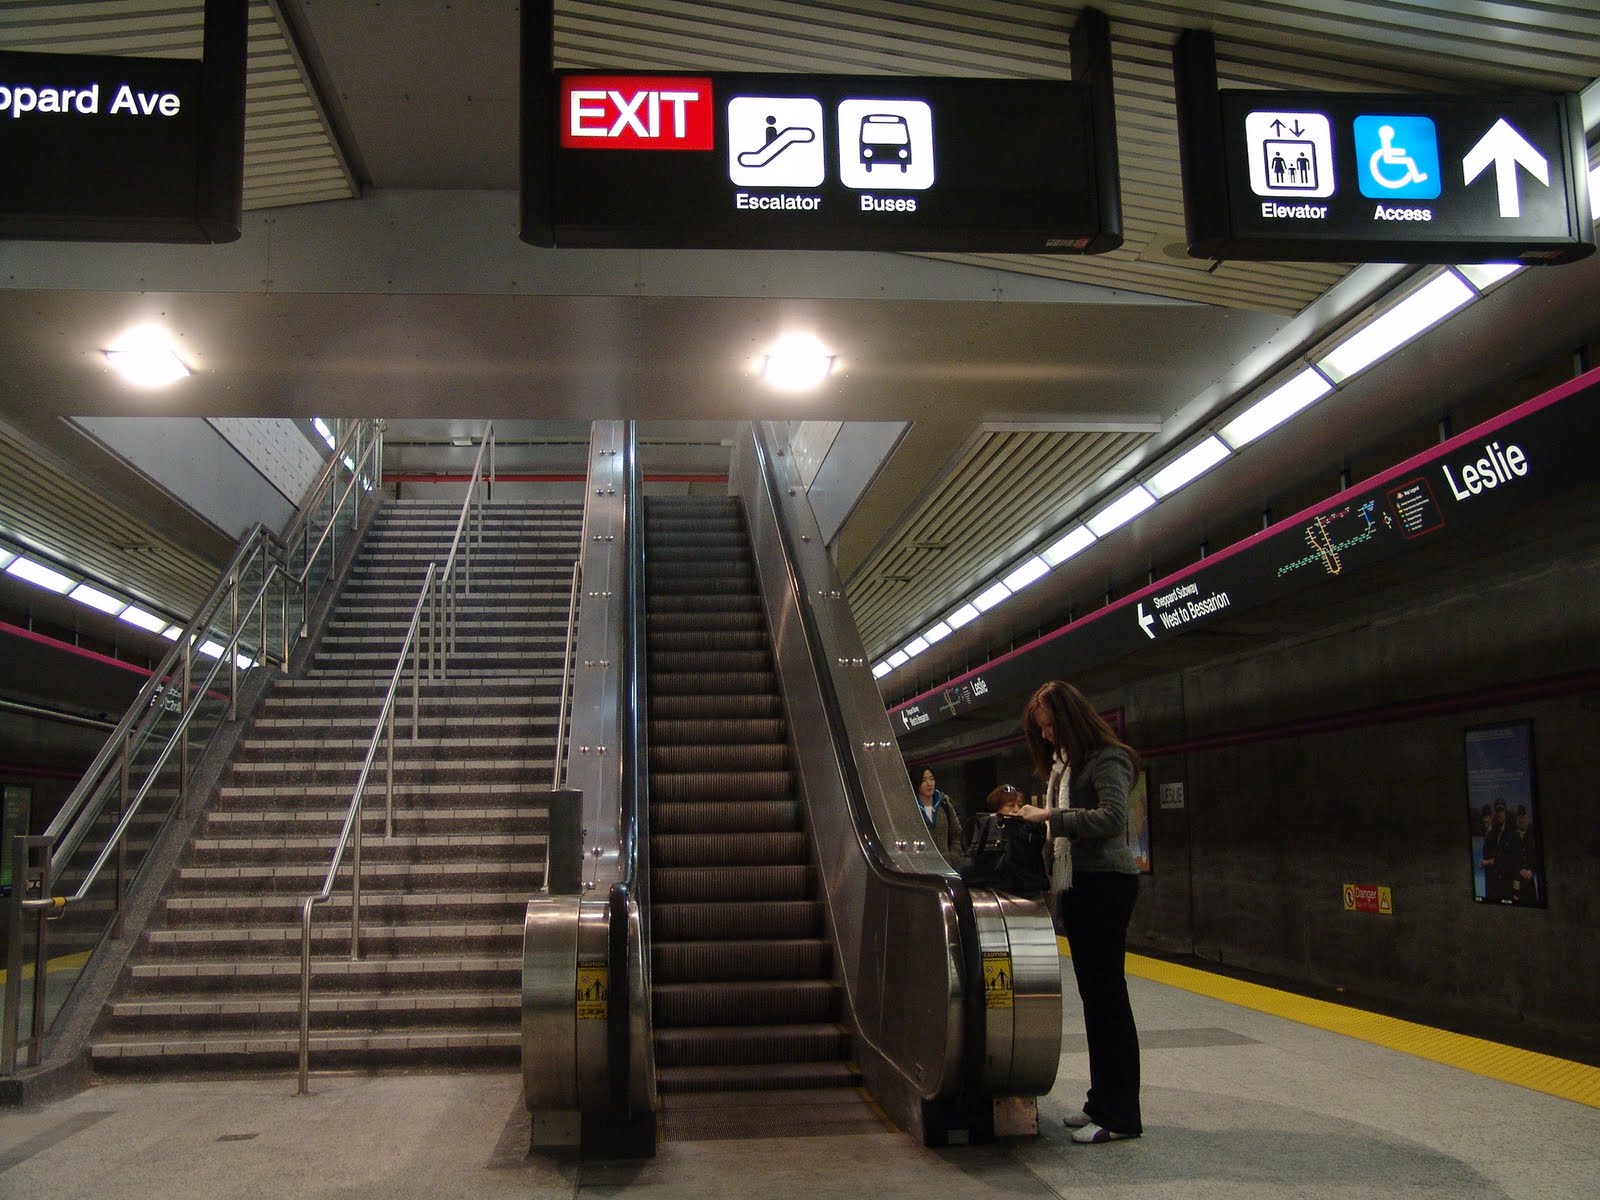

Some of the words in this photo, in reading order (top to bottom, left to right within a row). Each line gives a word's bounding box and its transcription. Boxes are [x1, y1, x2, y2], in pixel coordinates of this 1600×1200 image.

[110, 85, 181, 116] Ave
[570, 90, 699, 138] EXIT
[736, 193, 821, 211] Escalator
[860, 195, 917, 212] Buses
[1261, 202, 1328, 219] Elevator
[1373, 205, 1432, 221] Access
[1441, 441, 1528, 501] Leslie
[1153, 589, 1178, 609] Sheppard
[1176, 582, 1199, 599] Subway
[1160, 609, 1182, 630] West
[1179, 607, 1190, 623] to
[1187, 592, 1231, 619] Bessarion
[1355, 886, 1377, 902] Danger
